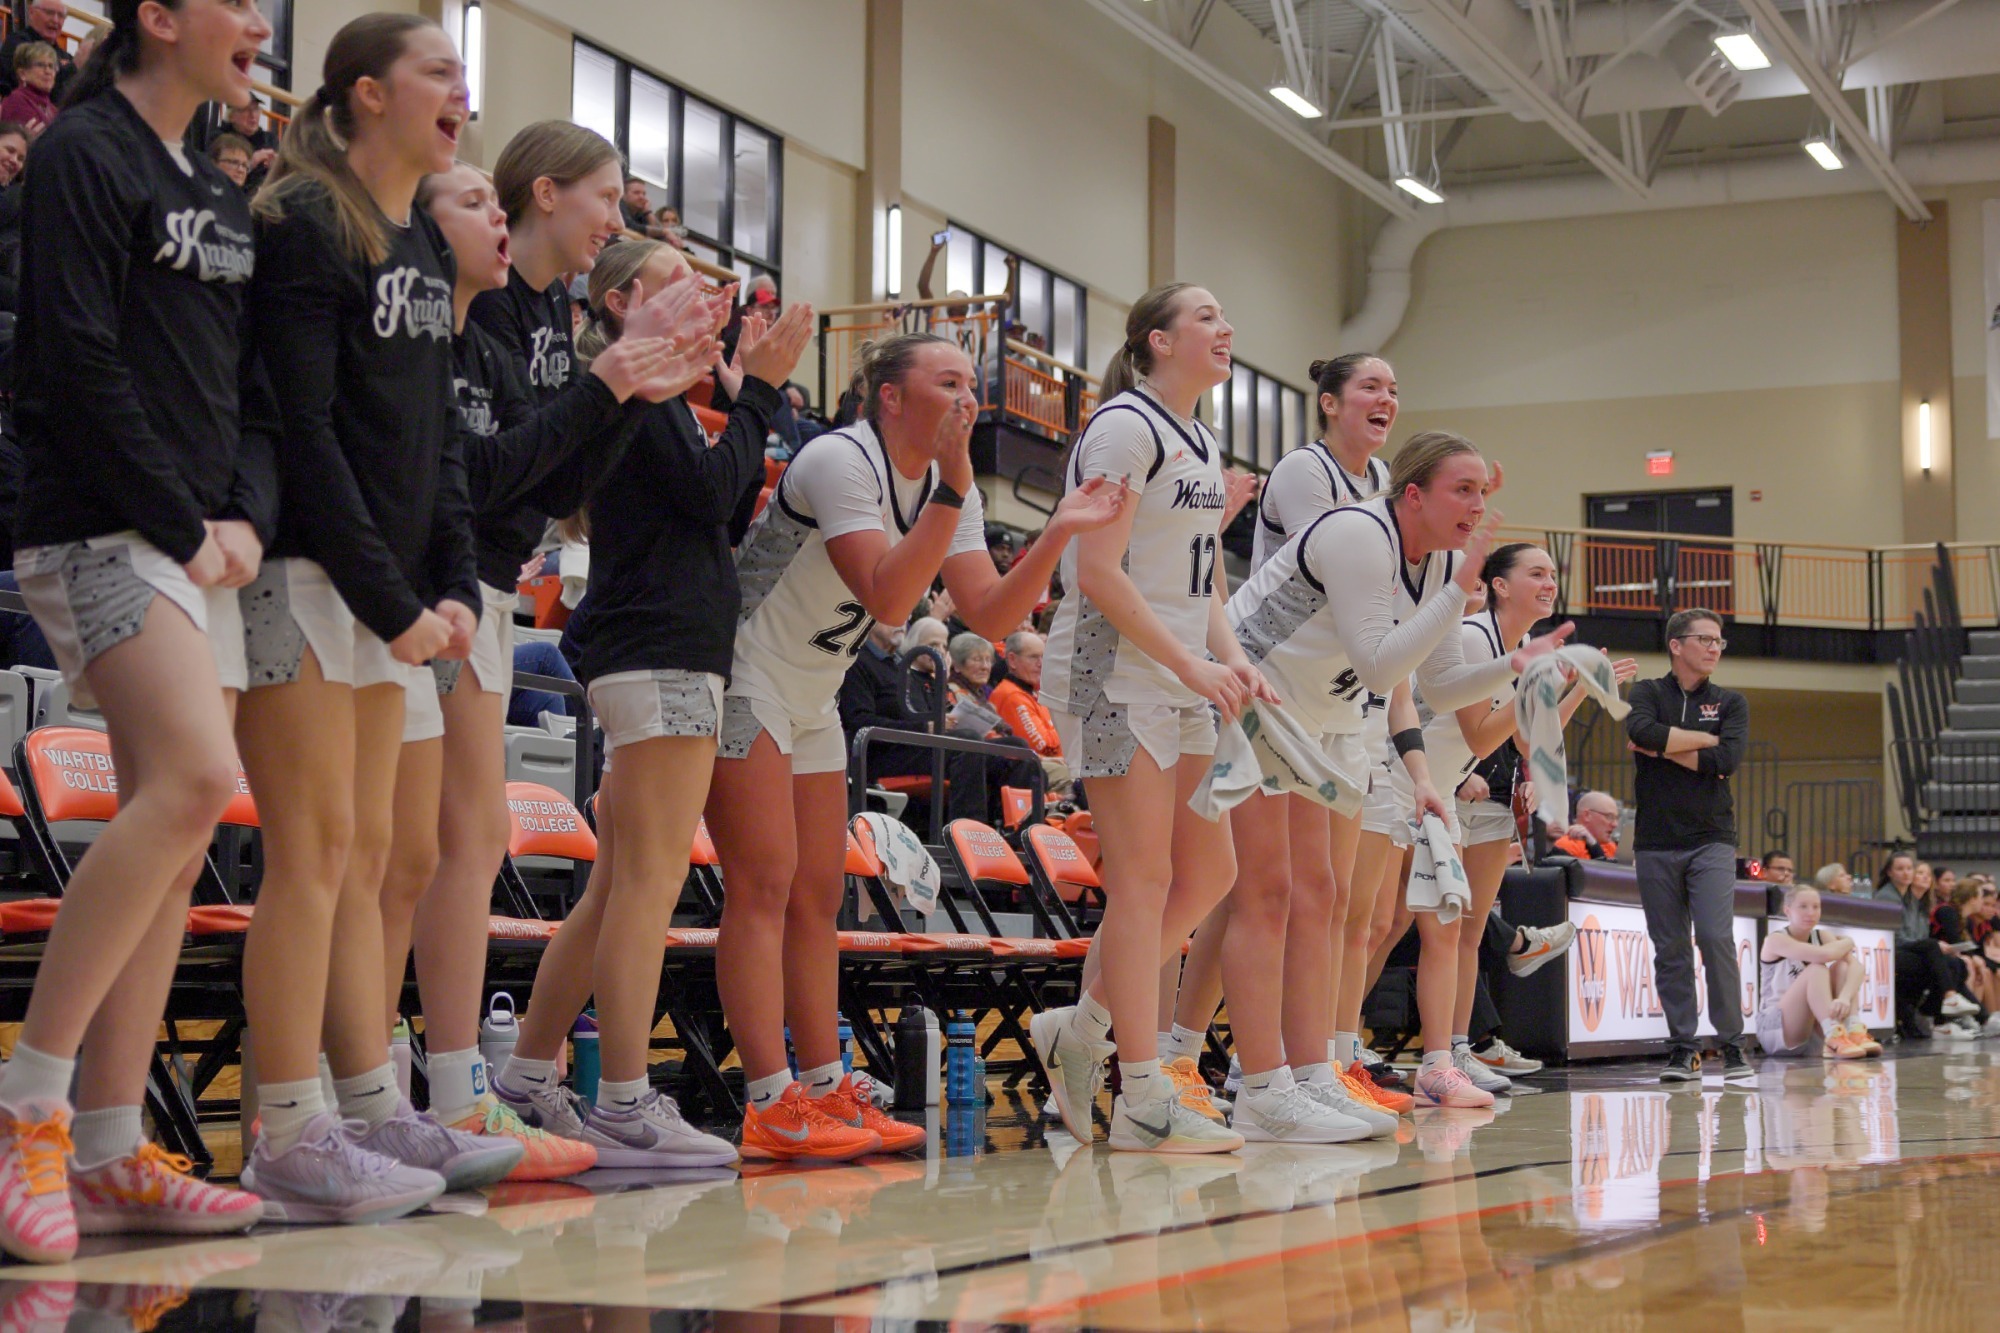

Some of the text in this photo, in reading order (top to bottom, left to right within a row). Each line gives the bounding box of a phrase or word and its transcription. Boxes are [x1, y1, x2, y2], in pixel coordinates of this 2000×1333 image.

[1188, 533, 1217, 597] 12
[507, 799, 580, 817] WARTBURG
[518, 815, 579, 833] COLLEGE
[959, 829, 1005, 844] WARTBURG
[970, 843, 1007, 858] COLLEGE
[491, 921, 543, 937] KNIGHTS
[852, 933, 892, 948] KNIGHTS
[945, 937, 985, 951] KNIGHTS
